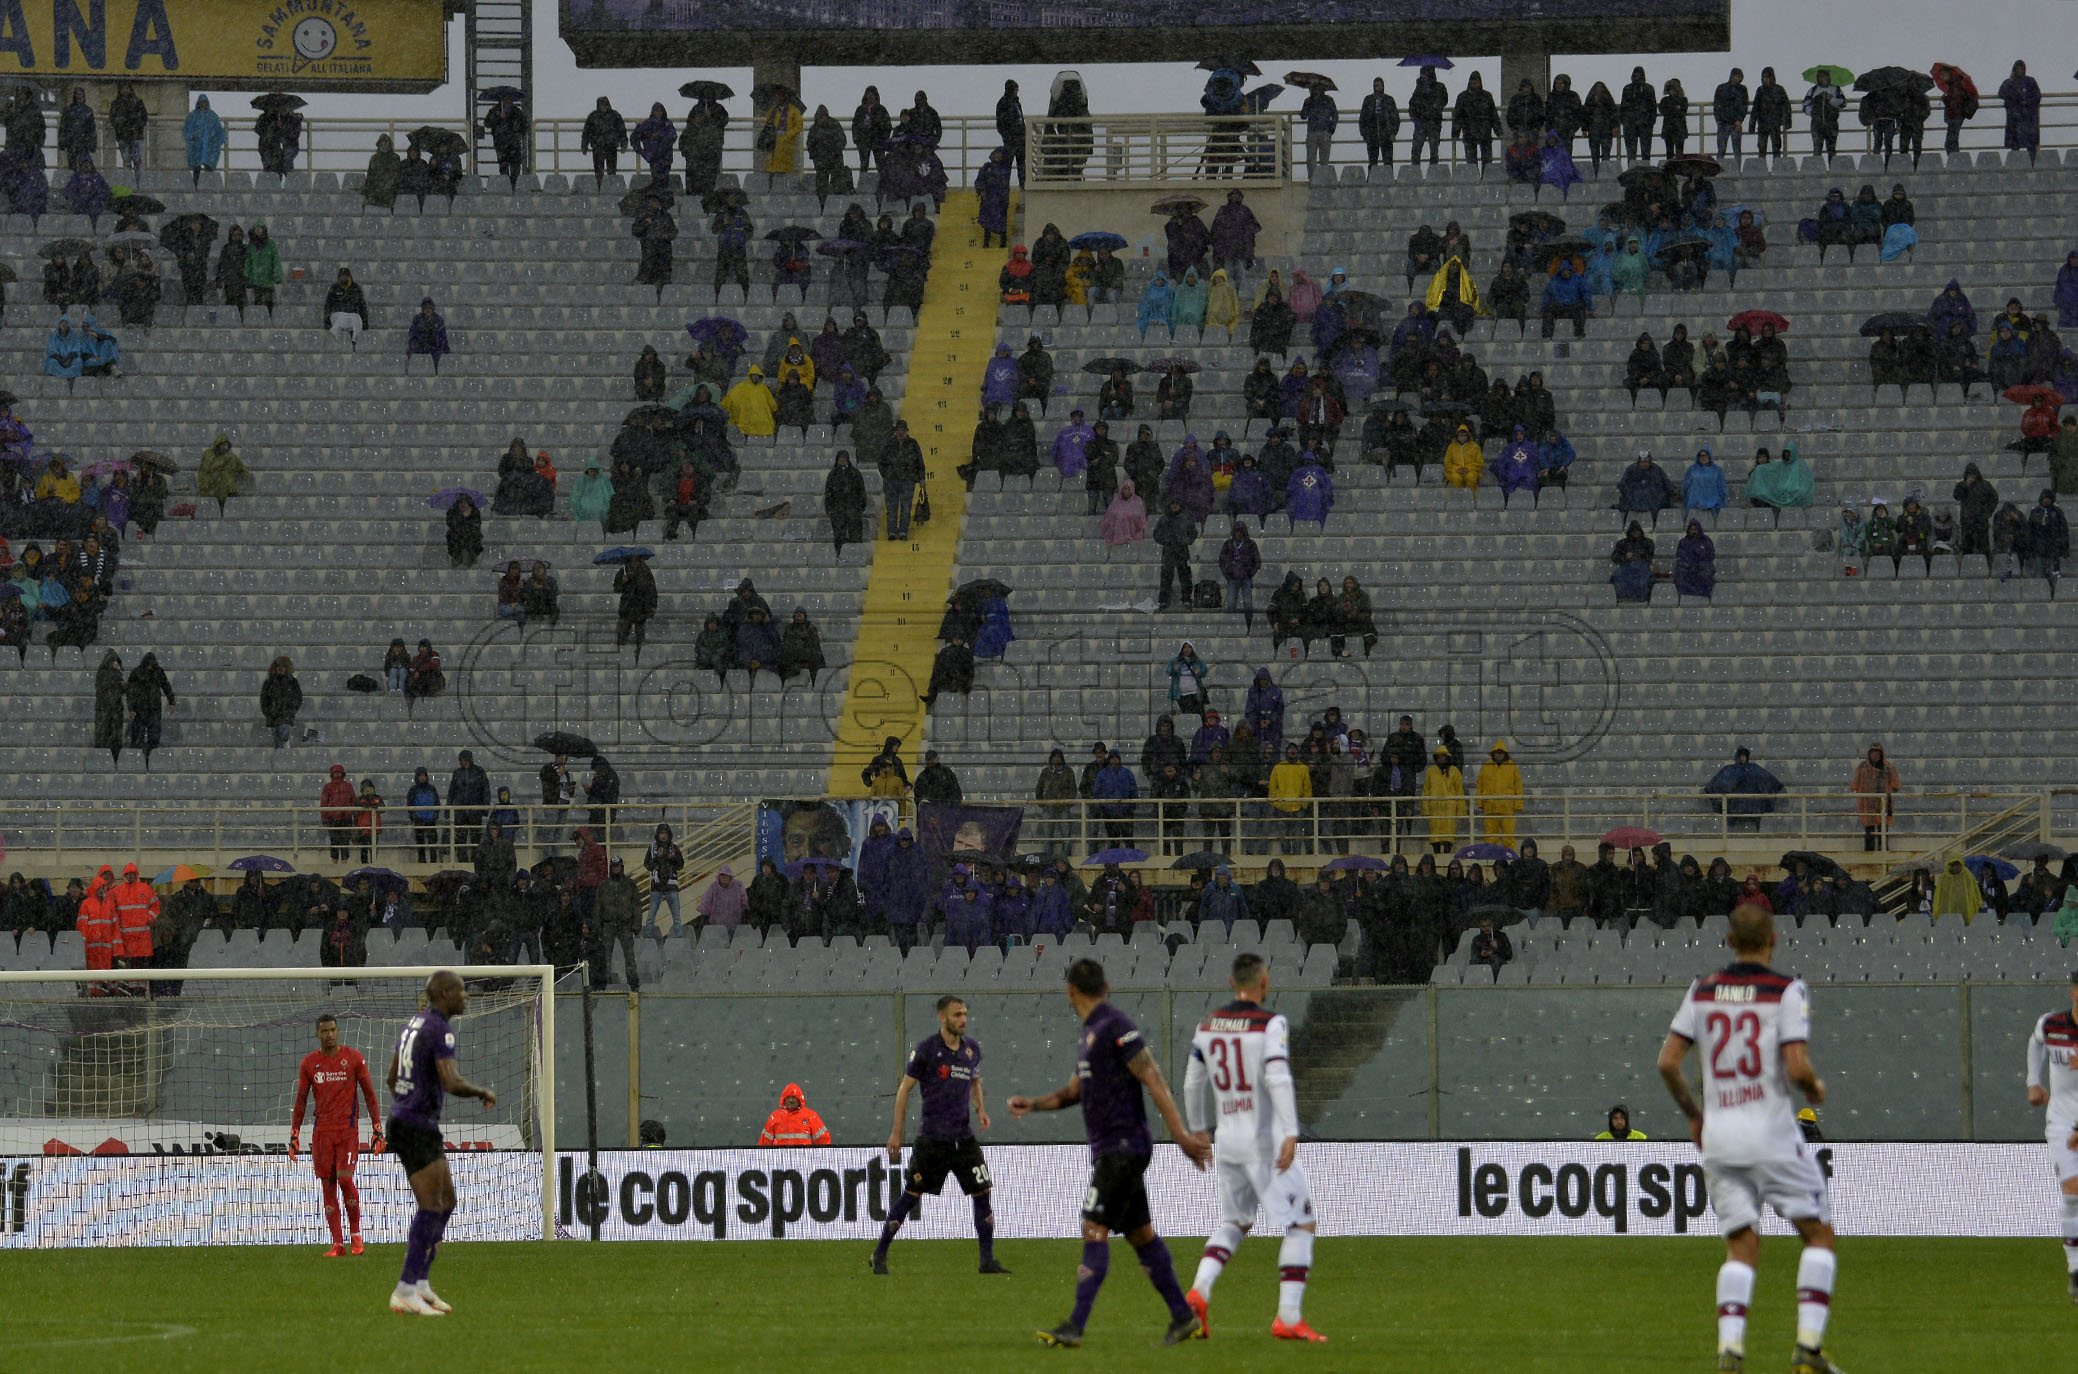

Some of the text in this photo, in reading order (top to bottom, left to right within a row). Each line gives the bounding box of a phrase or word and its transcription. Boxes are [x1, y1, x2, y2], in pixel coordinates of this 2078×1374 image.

[256, 62, 289, 74] GELATI
[397, 1028, 418, 1080] 14
[1209, 1036, 1252, 1092] 31
[1706, 1010, 1763, 1079] 23
[559, 1153, 921, 1239] le coq sporti
[971, 1164, 990, 1184] 20
[1457, 1148, 1509, 1218] le
[1519, 1162, 1628, 1233] coq
